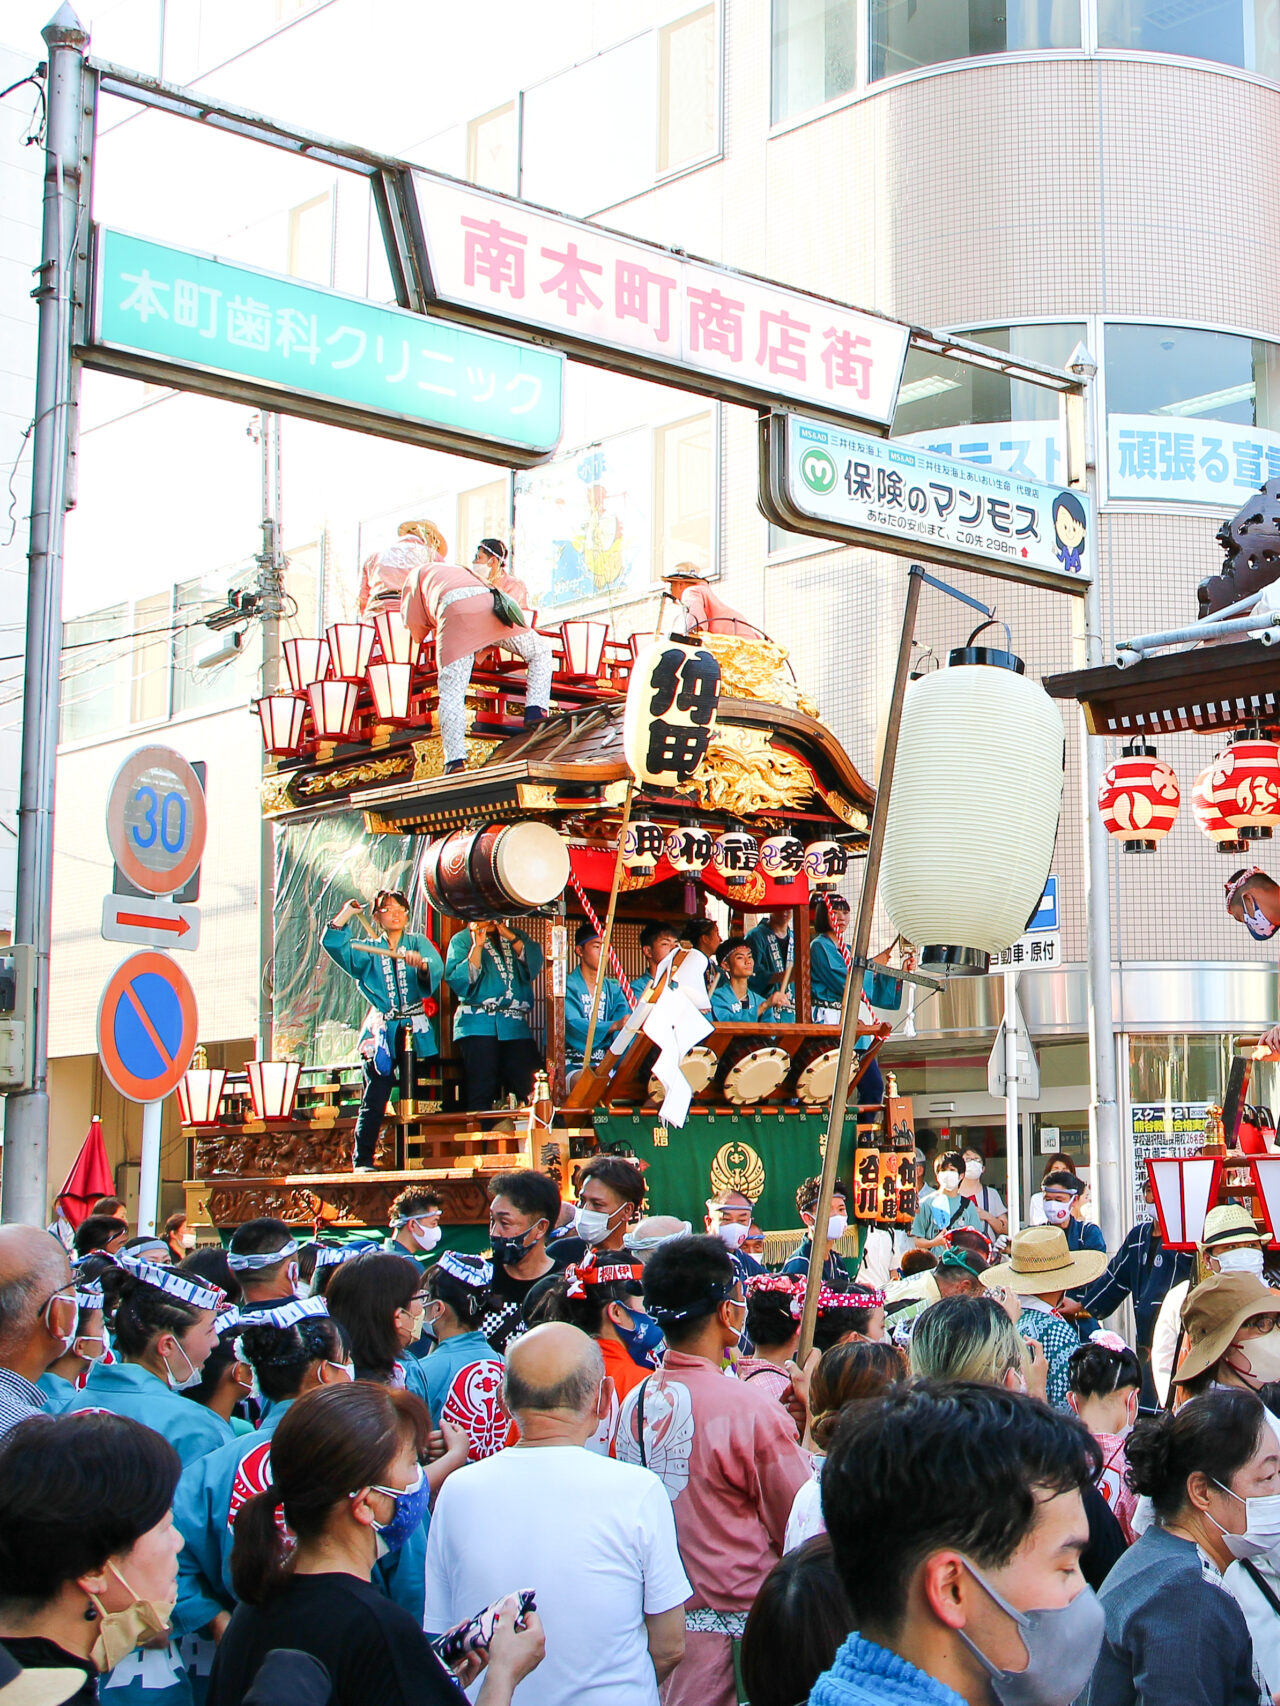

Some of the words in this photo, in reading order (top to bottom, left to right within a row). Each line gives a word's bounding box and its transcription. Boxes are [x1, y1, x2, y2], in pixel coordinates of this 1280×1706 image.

[119, 267, 543, 416] 本町歯科クリニック
[460, 215, 875, 402] 南本町商店街
[801, 429, 827, 442] MS&AD
[830, 435, 883, 458] 三井住友海上
[890, 451, 915, 465] MS&AD
[917, 458, 1011, 492] 三井住友海上あいおい生命
[1016, 485, 1039, 499] 代理店
[844, 459, 1039, 540] 保険のマンモス
[132, 785, 187, 854] 30
[858, 1154, 879, 1214] 谷川
